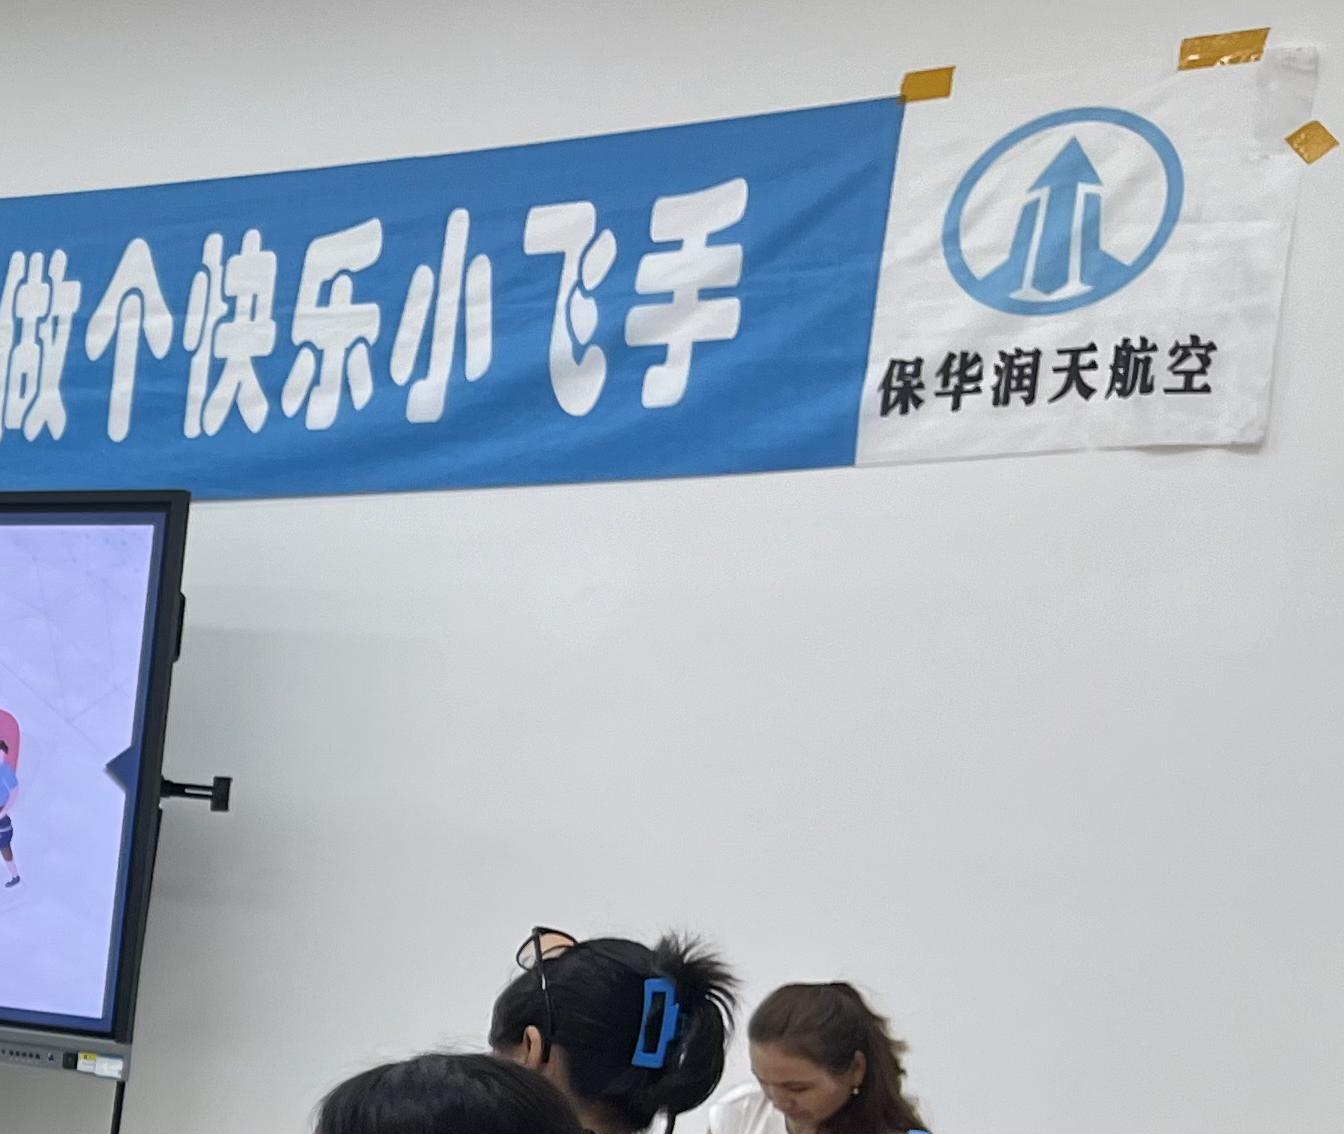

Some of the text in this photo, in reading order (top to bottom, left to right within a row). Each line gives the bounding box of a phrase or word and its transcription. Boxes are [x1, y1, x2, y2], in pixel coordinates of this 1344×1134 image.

[878, 334, 1218, 416] 保华润天航空
